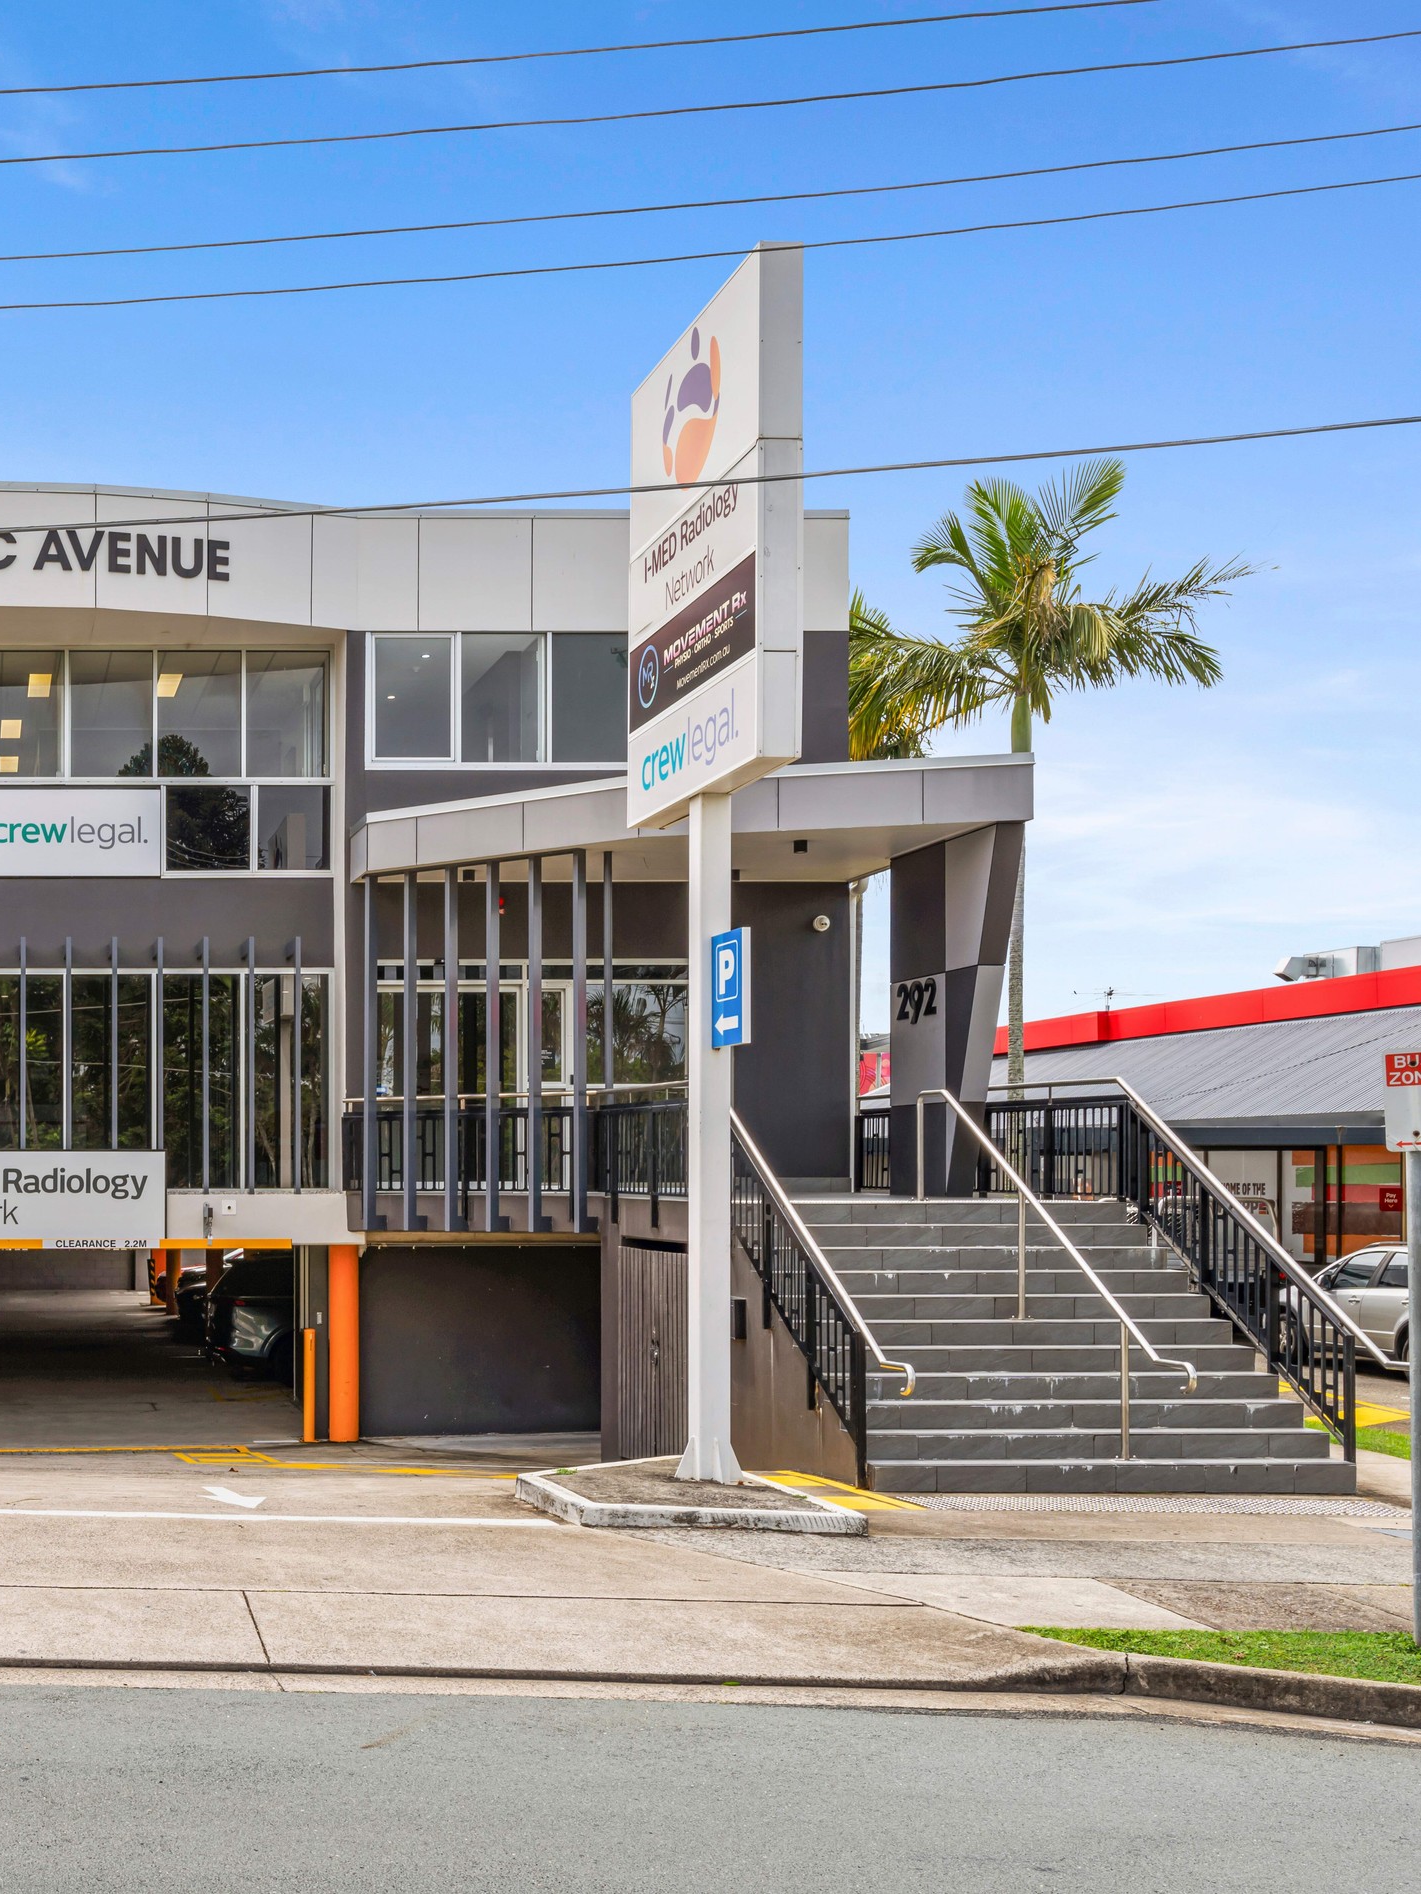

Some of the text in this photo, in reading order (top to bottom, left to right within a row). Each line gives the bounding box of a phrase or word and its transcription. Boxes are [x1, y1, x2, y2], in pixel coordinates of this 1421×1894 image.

[33, 530, 230, 581] AVENUE
[644, 483, 739, 583] I-MED Radiology
[665, 544, 715, 611] Network
[663, 591, 747, 666] MOVEMENT Rx
[674, 616, 734, 669] PHYSIO ORTHO SPORTS
[718, 949, 735, 995] P
[896, 977, 937, 1024] 292
[1389, 1070, 1421, 1085] ZON
[1394, 1054, 1421, 1068] BU
[2, 1167, 148, 1200] Radiology
[1242, 1183, 1251, 1195] OF
[1252, 1183, 1266, 1195] THE
[55, 1240, 147, 1248] CLEARANCE 2.2M
